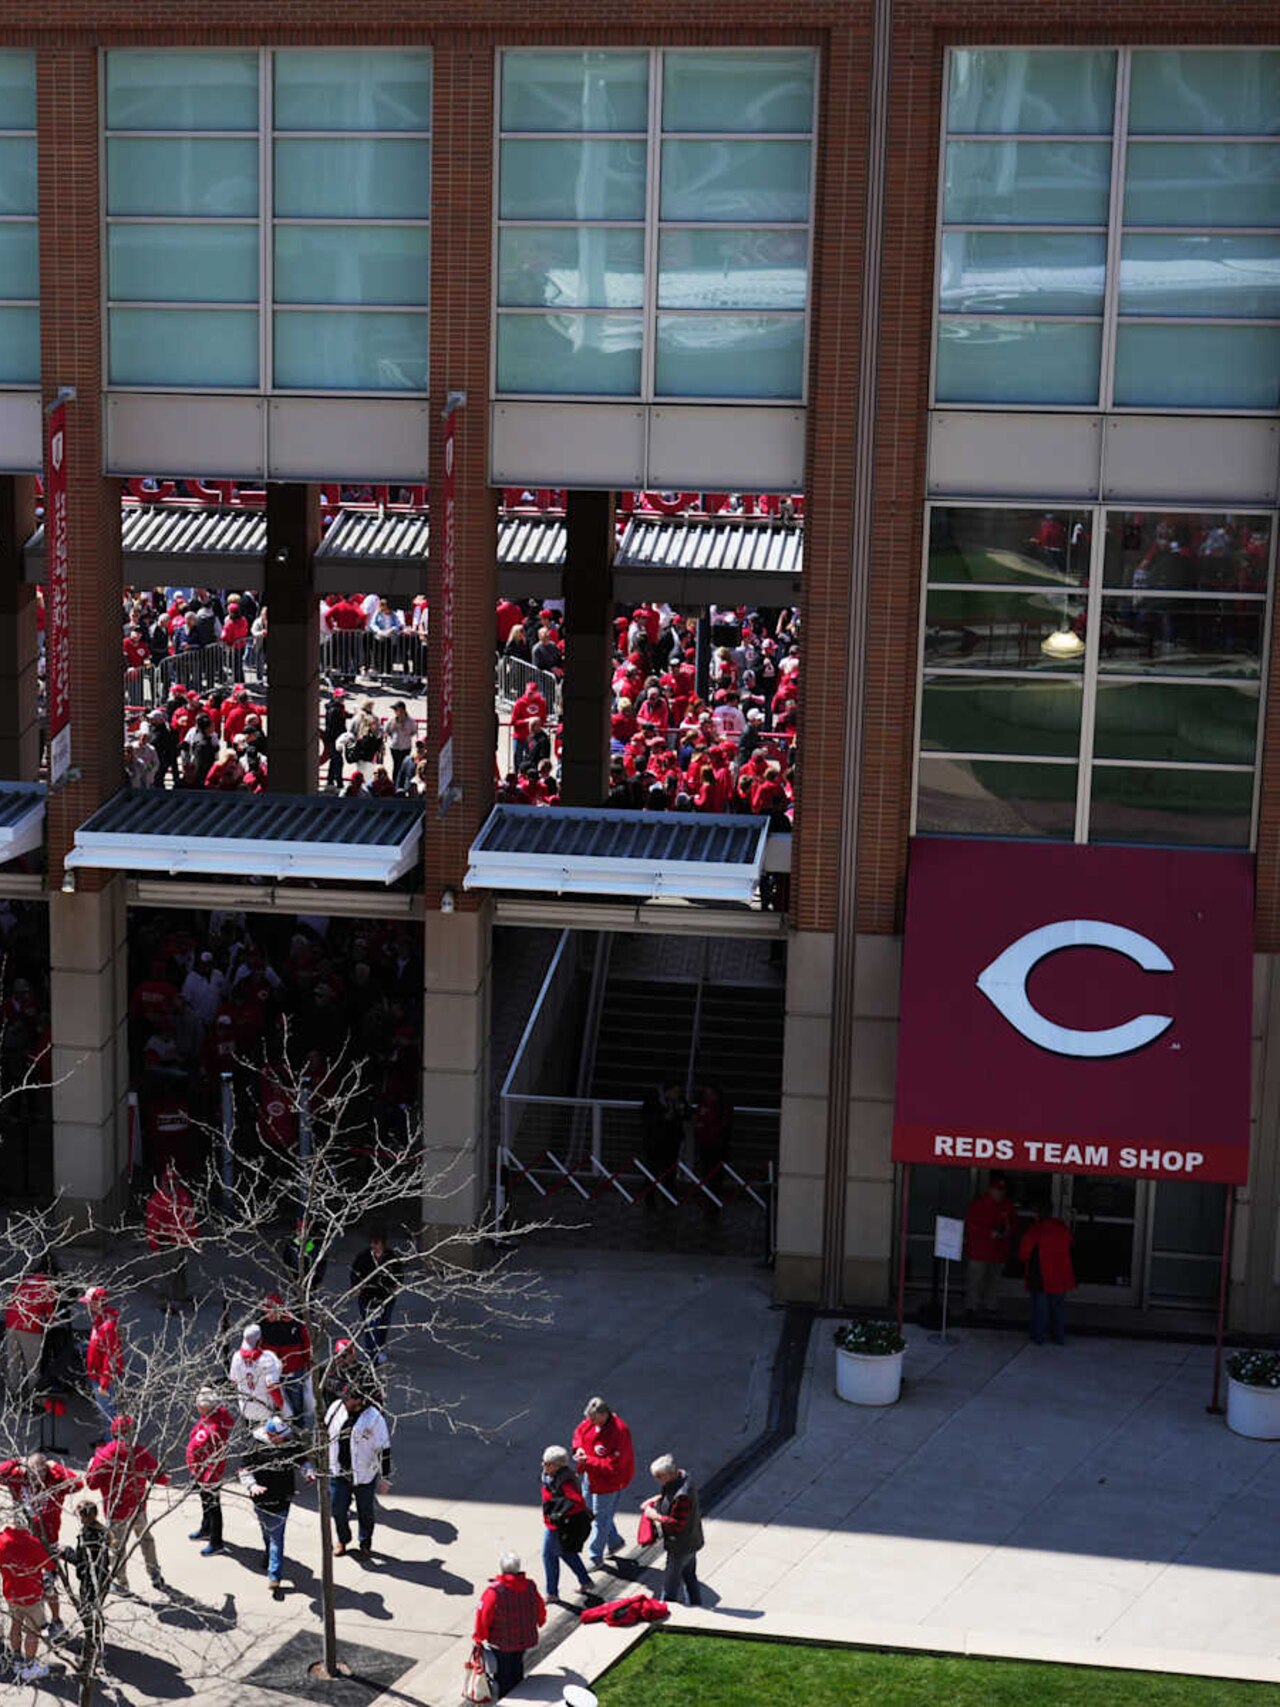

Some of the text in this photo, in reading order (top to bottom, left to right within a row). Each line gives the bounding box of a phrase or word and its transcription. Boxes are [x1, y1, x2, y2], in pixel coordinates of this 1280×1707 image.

[976, 919, 1174, 1058] C
[934, 1135, 1204, 1173] REDS TEAM SHOP
